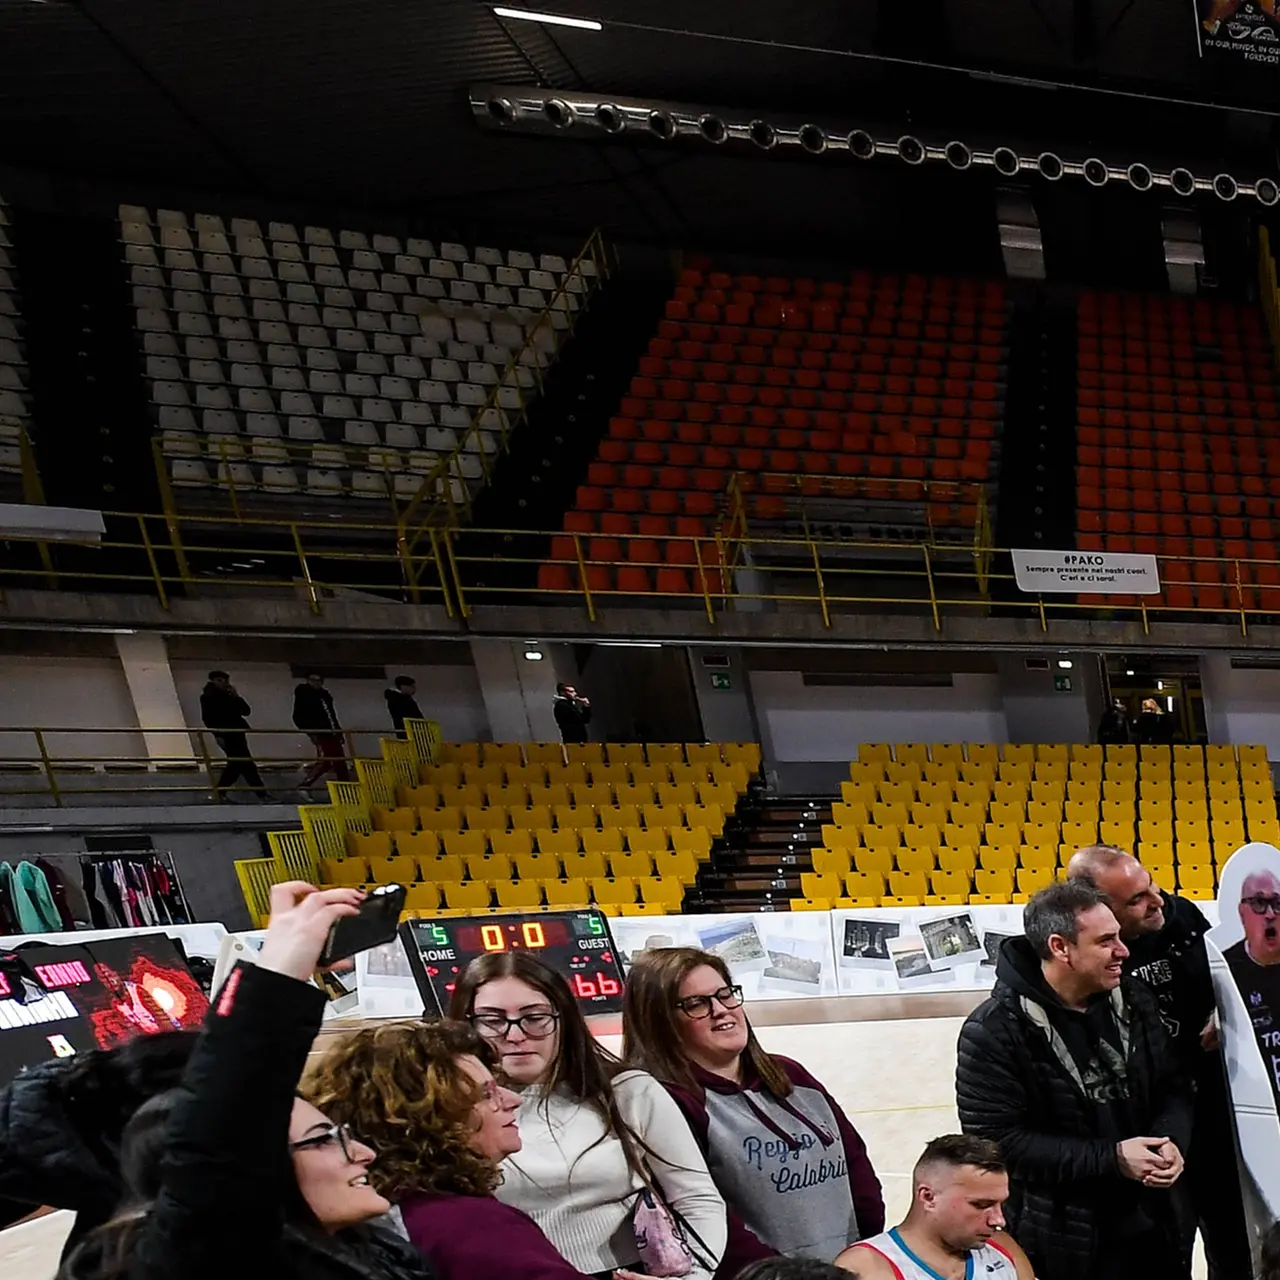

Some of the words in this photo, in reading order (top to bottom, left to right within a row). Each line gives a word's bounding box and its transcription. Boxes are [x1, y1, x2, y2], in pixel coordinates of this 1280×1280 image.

[1026, 565, 1054, 574] Sempre
[1056, 566, 1089, 574] presente
[1064, 555, 1104, 566] #PAKO
[588, 917, 603, 935] 5
[432, 926, 448, 946] 5
[419, 949, 457, 962] HOME
[578, 937, 609, 950] GUEST
